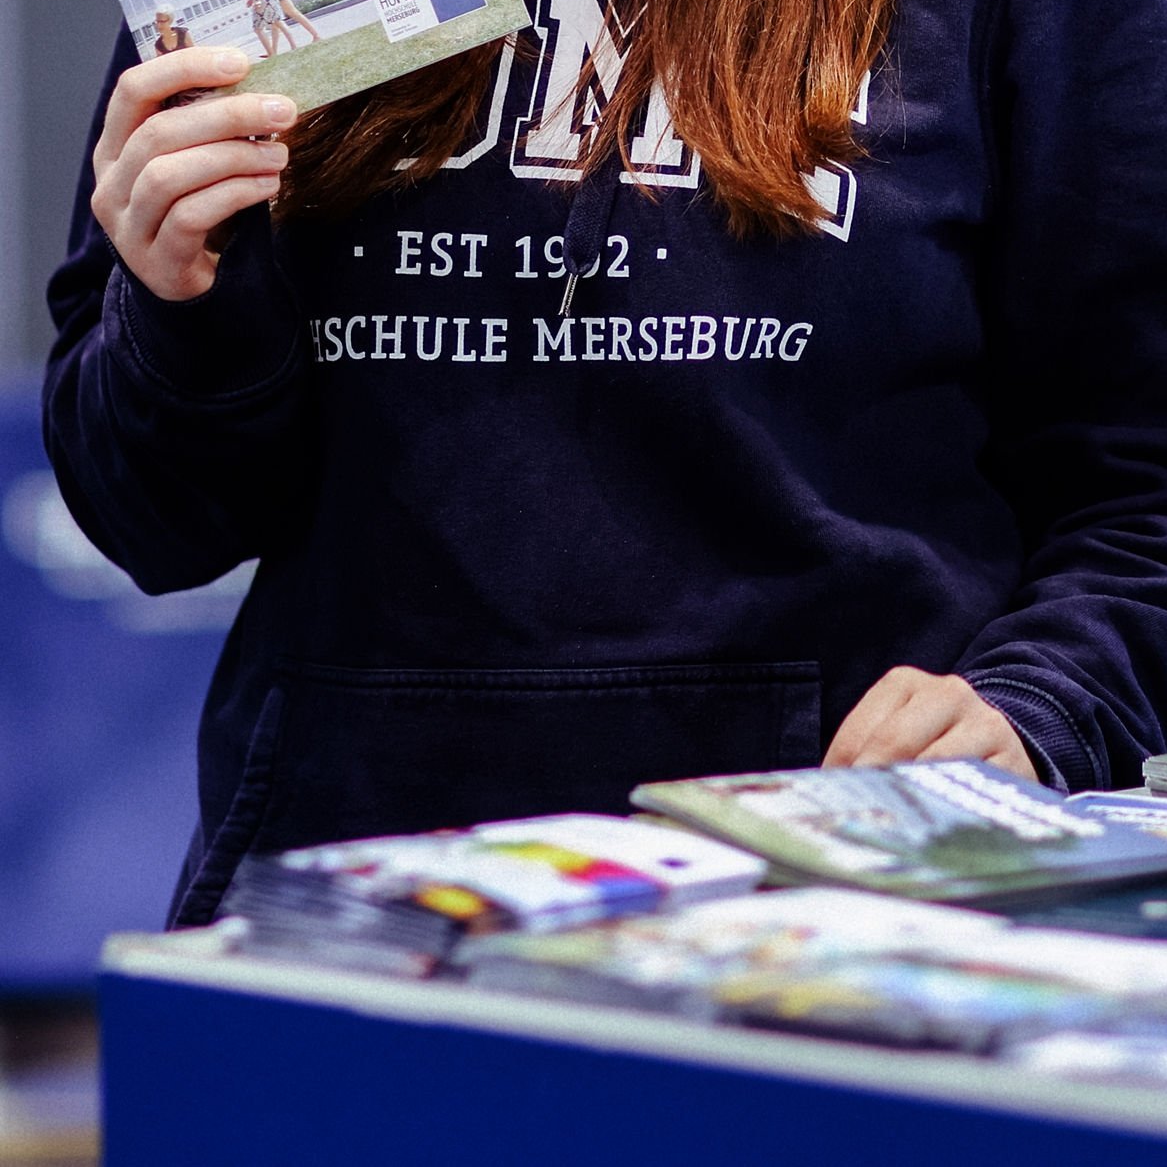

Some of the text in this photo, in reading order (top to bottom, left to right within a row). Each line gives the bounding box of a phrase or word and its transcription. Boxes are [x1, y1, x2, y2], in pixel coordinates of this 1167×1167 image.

[386, 7, 421, 24] MERSEBURG
[395, 230, 488, 278] EST
[532, 315, 814, 362] MERSEBURG
